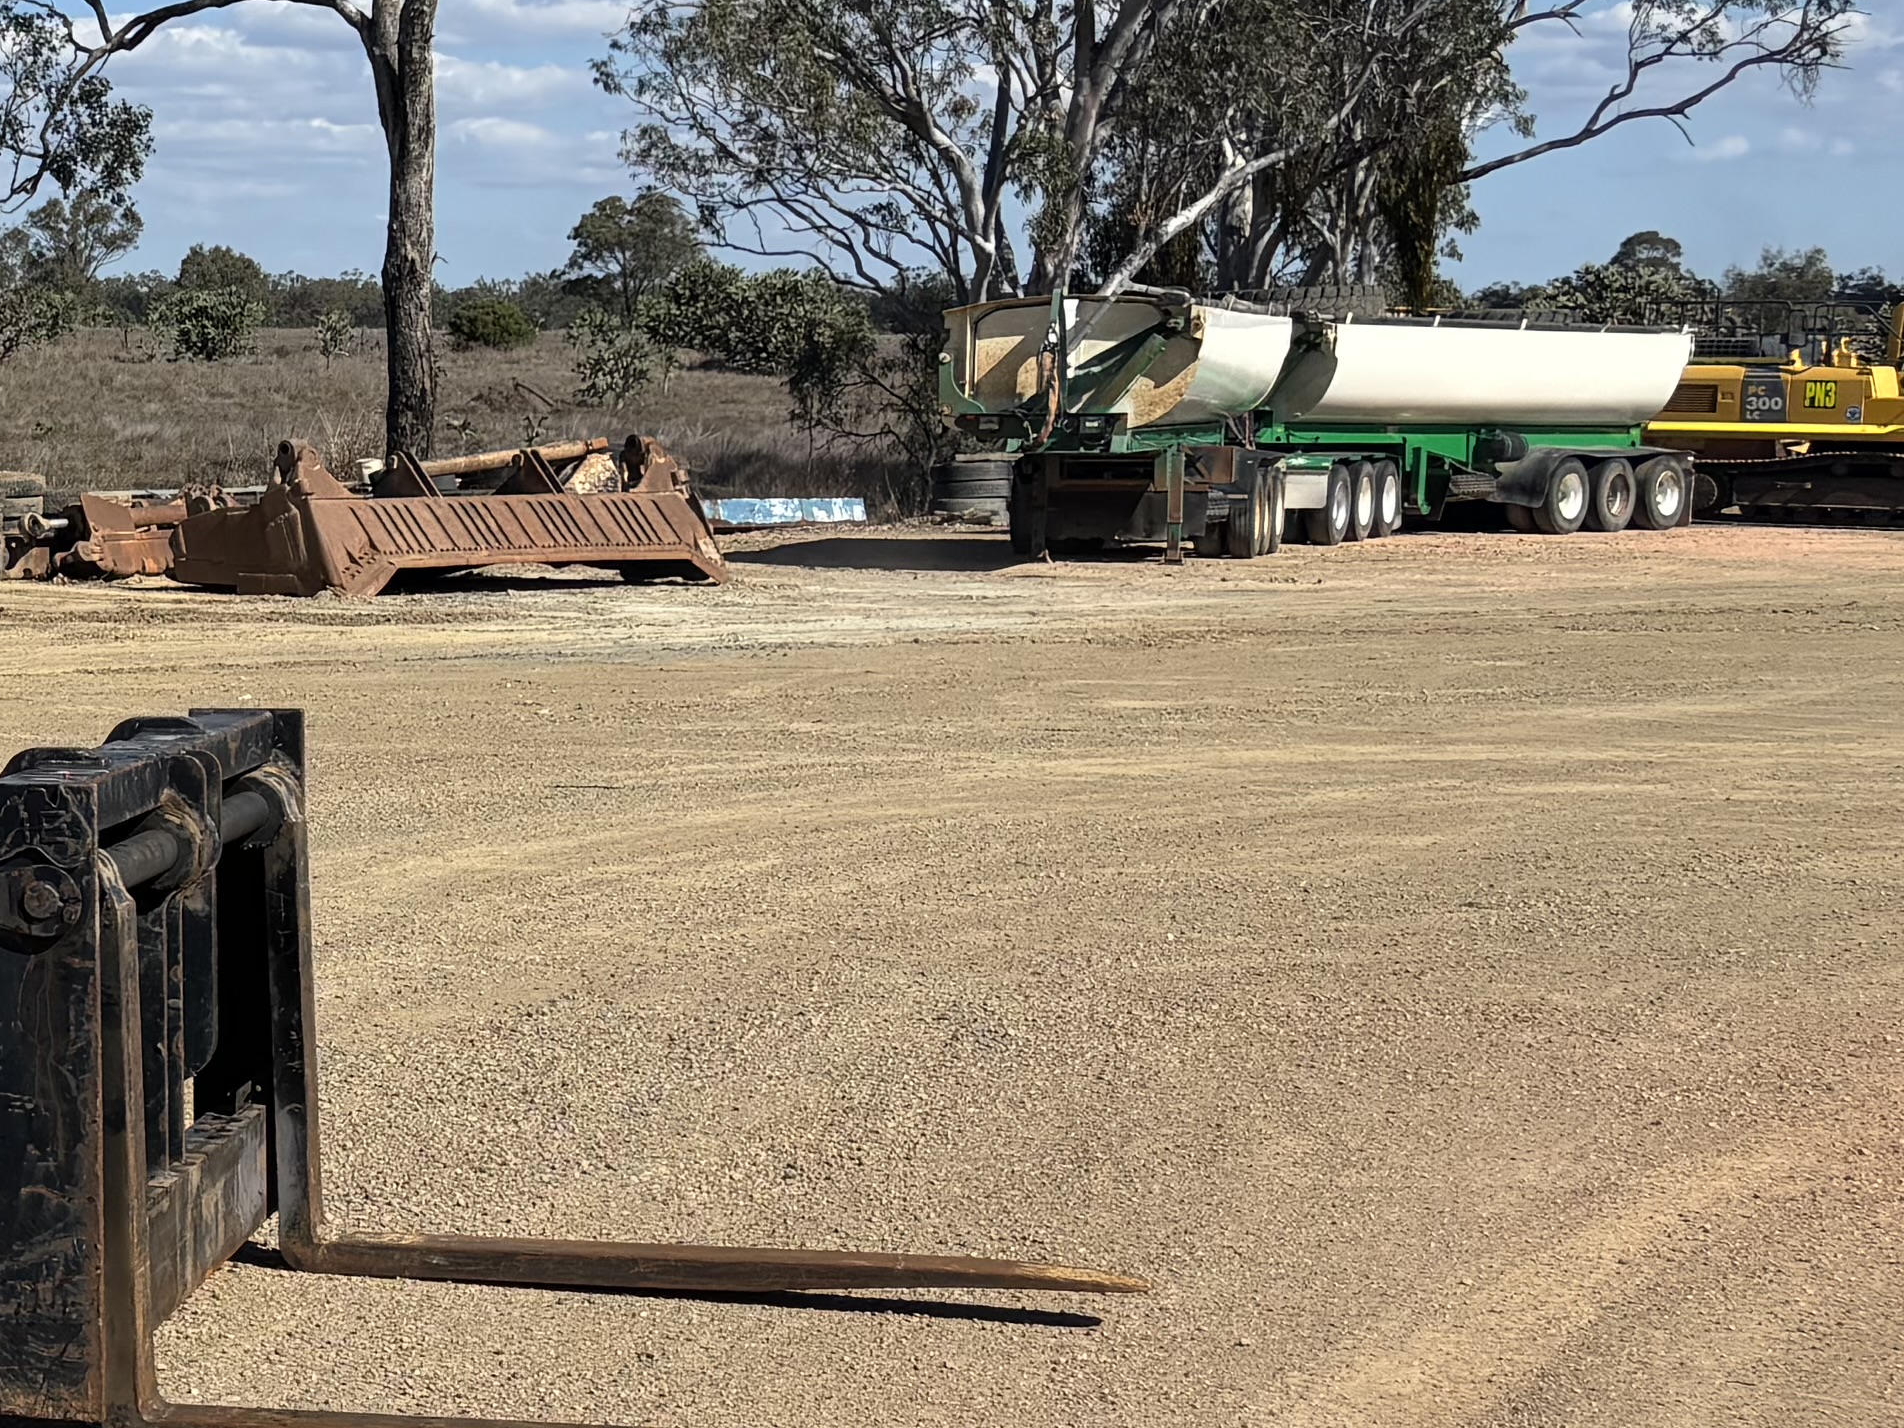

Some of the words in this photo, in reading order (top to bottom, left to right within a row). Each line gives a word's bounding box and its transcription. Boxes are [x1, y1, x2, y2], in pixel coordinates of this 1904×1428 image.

[1747, 385, 1767, 396] PC
[1805, 382, 1836, 407] PN3
[1745, 396, 1783, 410] 300
[1746, 410, 1761, 420] LC
